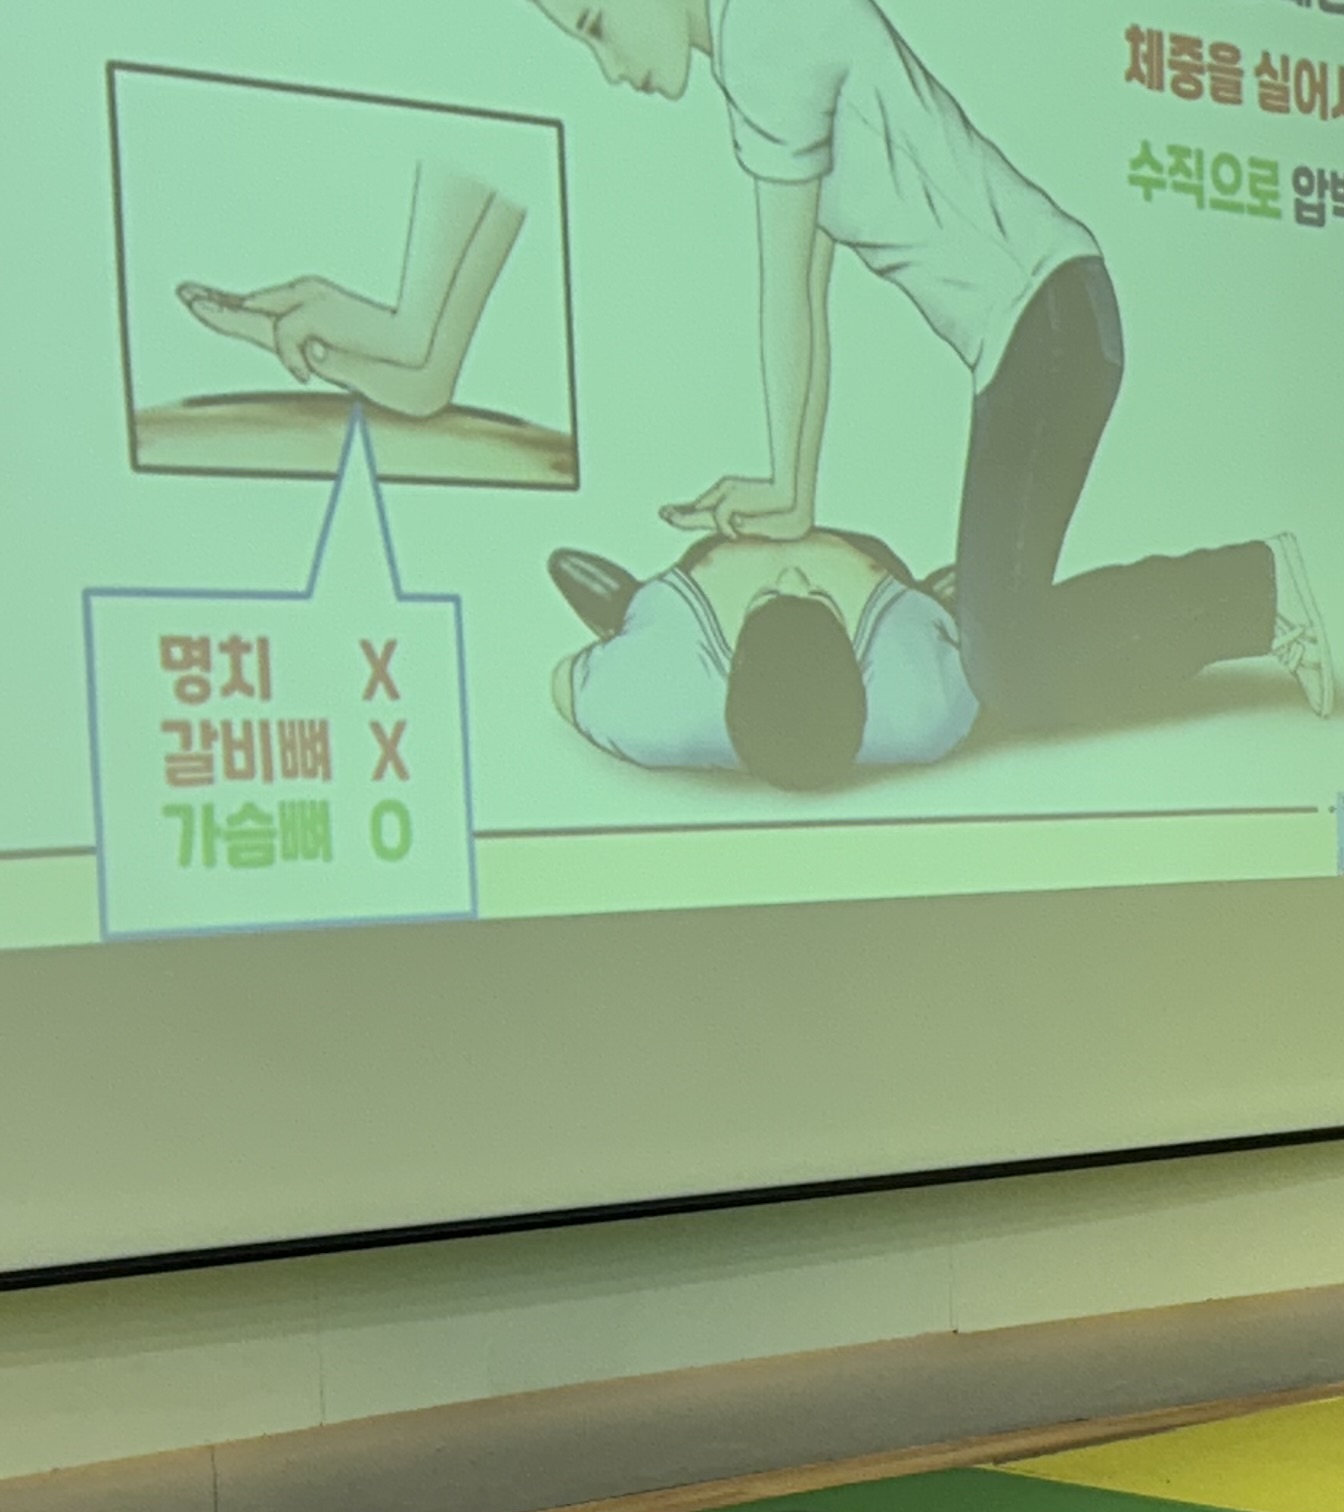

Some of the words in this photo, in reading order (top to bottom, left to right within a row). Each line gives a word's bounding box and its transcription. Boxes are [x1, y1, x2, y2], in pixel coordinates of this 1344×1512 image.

[1124, 22, 1244, 106] 체중을
[1127, 139, 1283, 220] 수직으로
[159, 634, 272, 706] 명치
[358, 637, 401, 702] X
[160, 717, 333, 788] 갈비뼈
[368, 718, 411, 783] X
[161, 799, 334, 869] 가슴뼈
